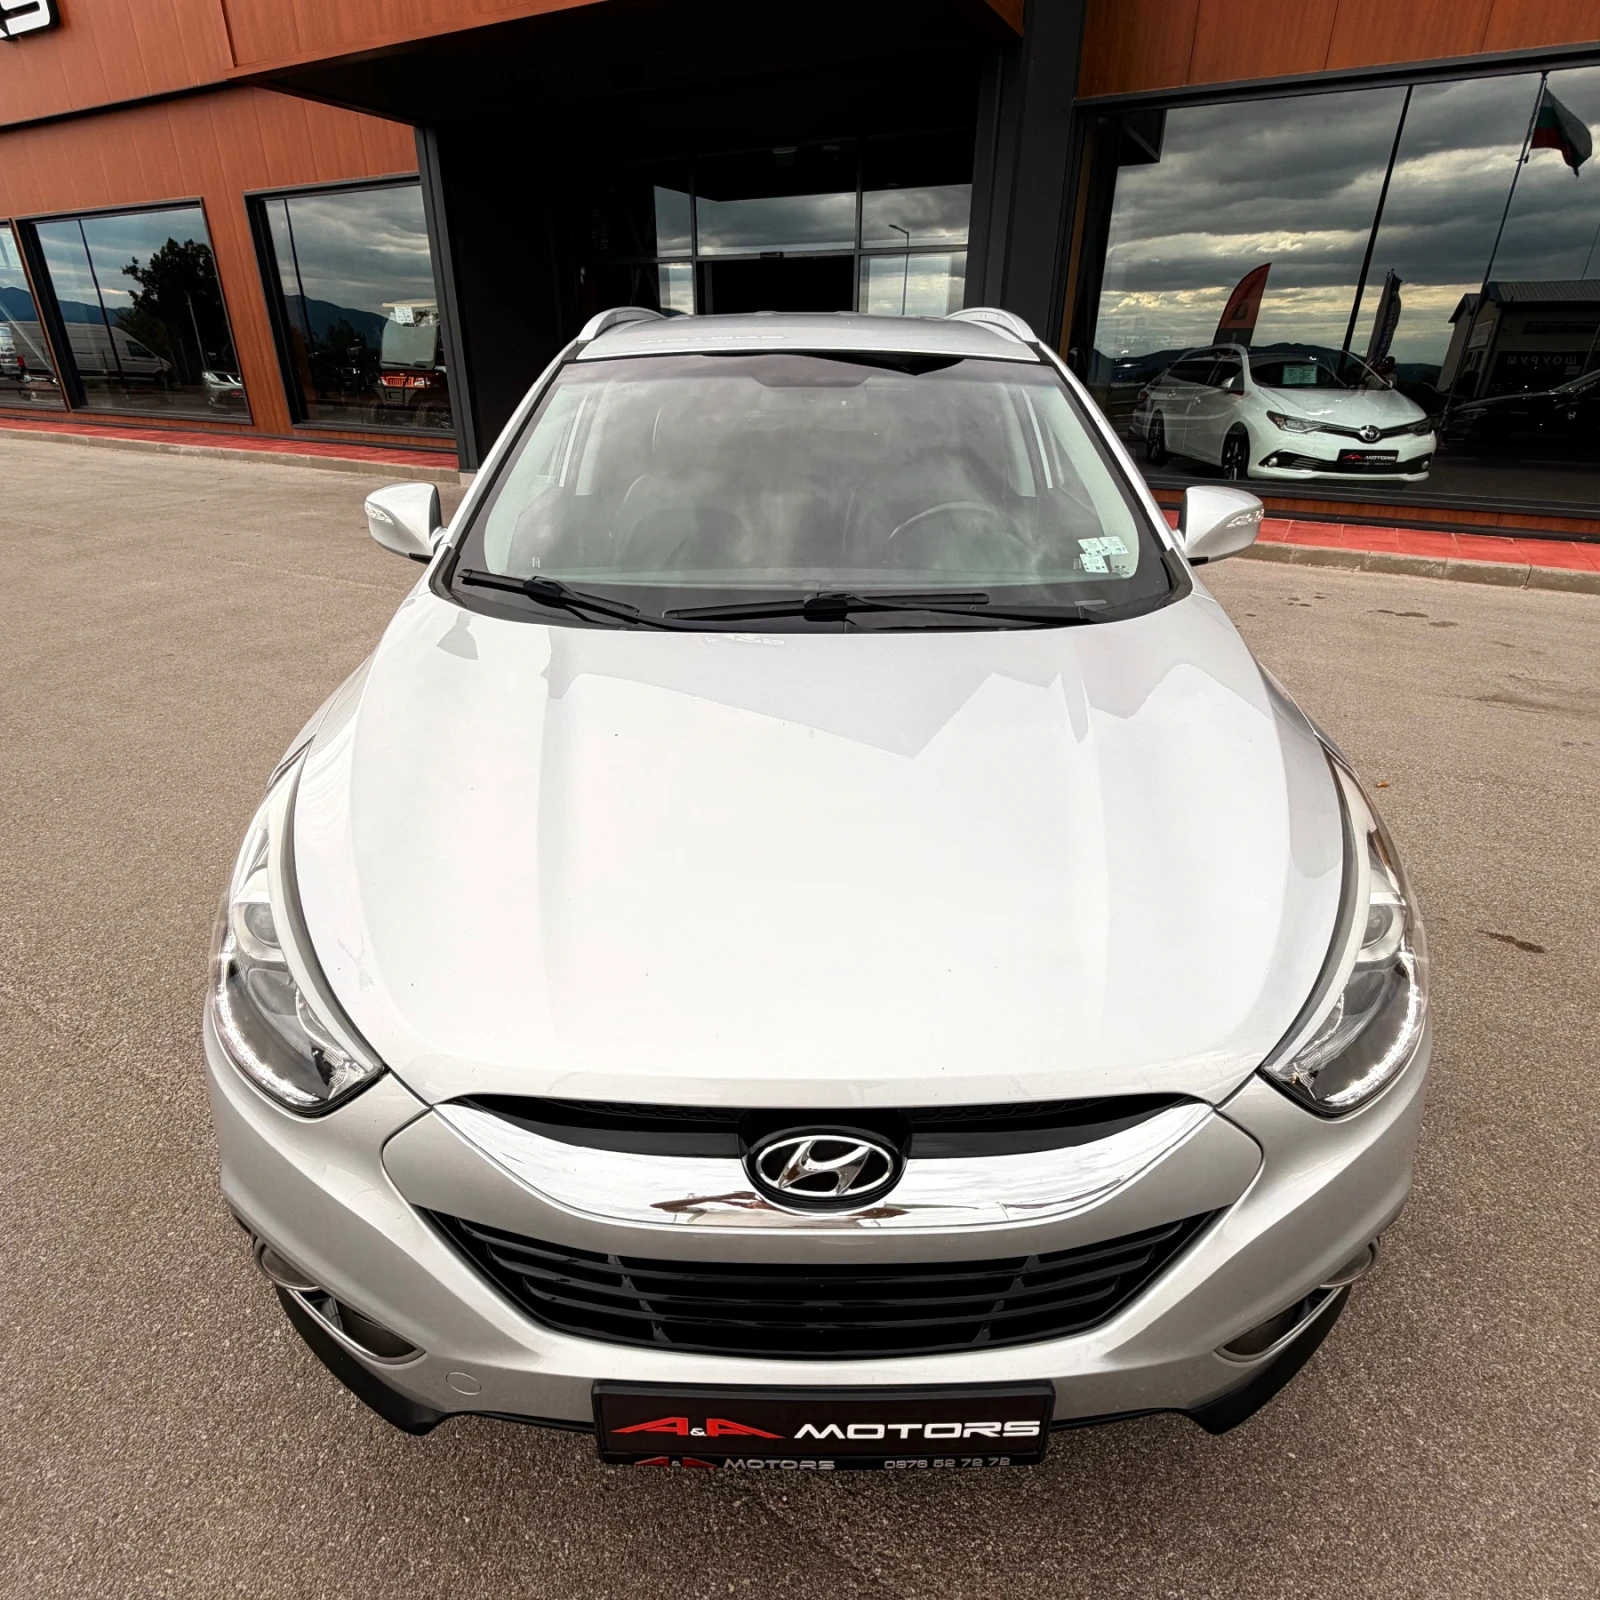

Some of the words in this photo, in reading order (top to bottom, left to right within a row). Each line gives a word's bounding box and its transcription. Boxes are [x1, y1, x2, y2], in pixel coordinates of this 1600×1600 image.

[794, 1421, 1040, 1439] MOTORS
[723, 1458, 835, 1470] MOTORS
[960, 1458, 983, 1466] 72
[988, 1456, 1011, 1466] 72
